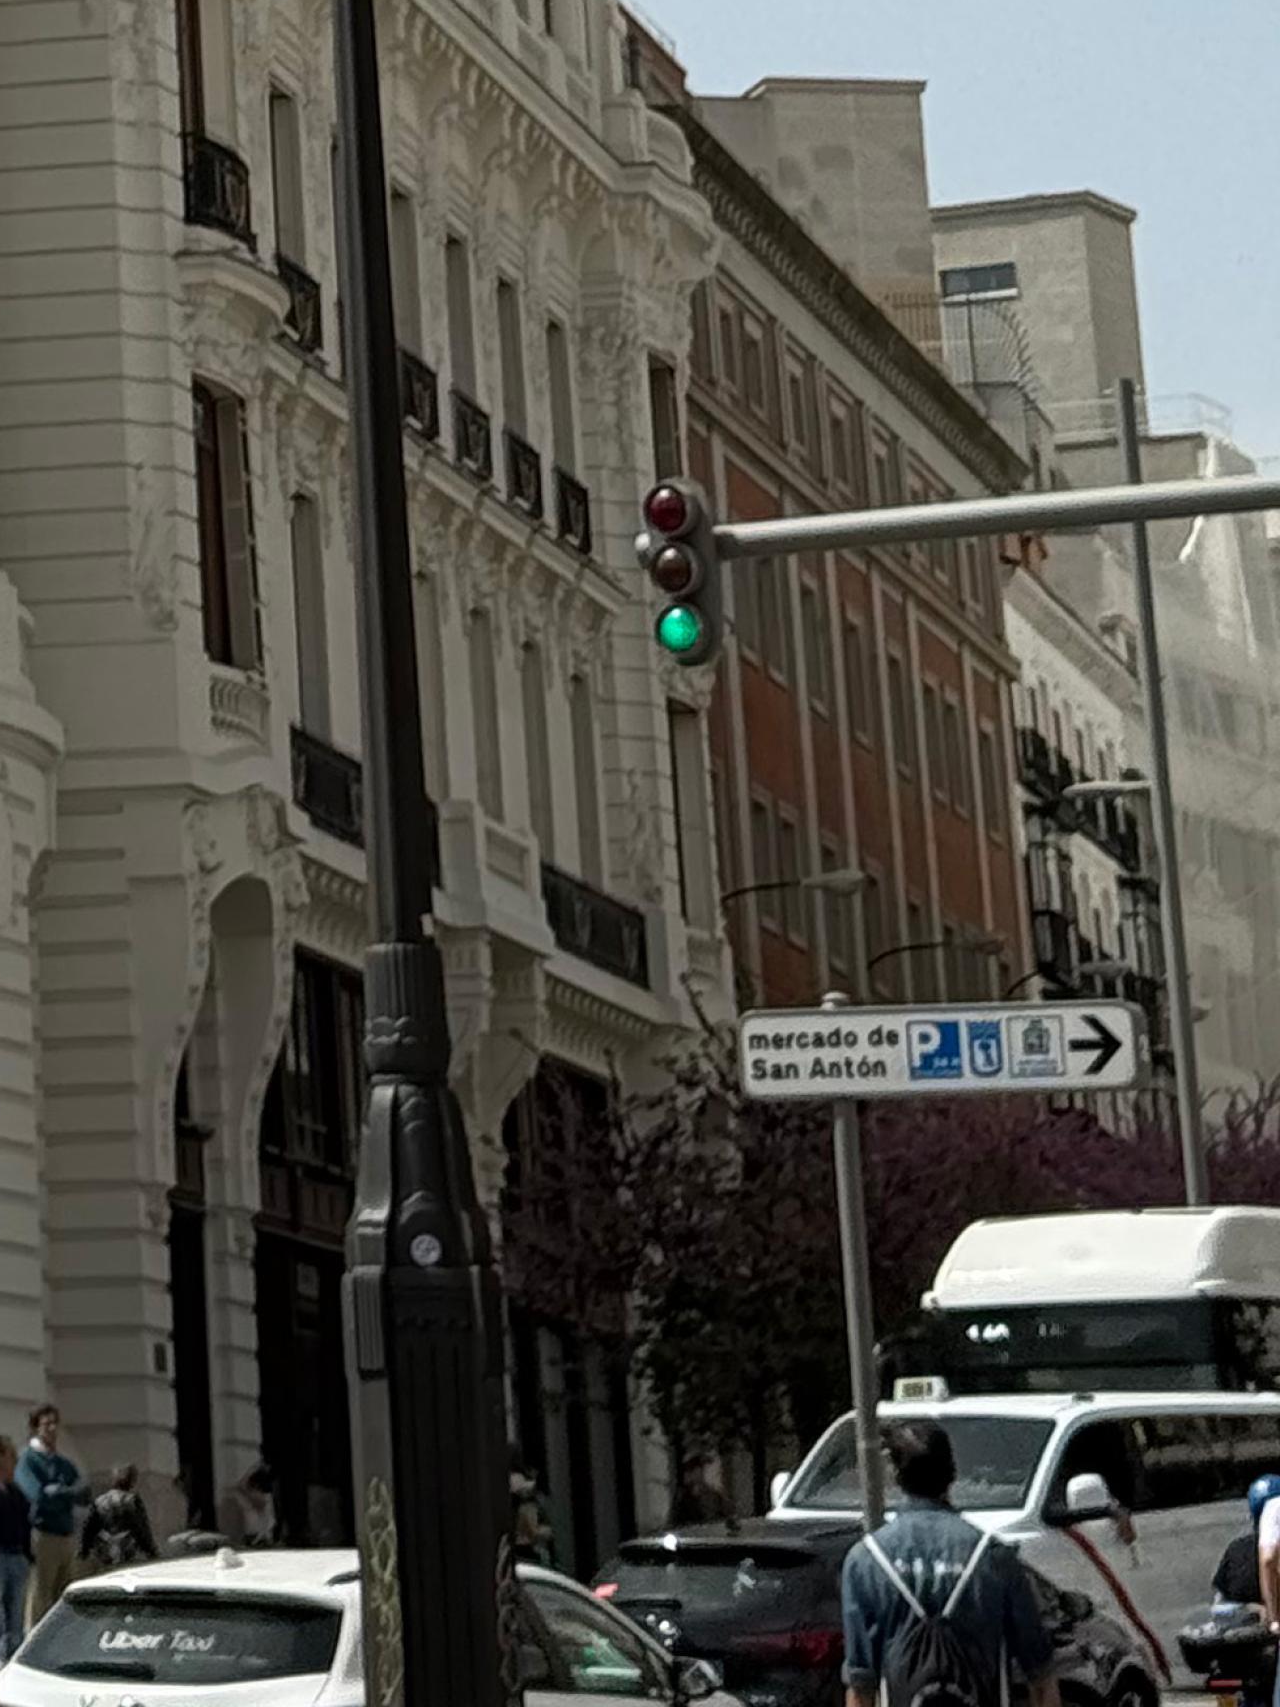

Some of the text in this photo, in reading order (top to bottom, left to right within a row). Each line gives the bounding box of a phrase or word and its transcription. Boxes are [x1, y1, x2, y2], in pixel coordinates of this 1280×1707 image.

[748, 1024, 899, 1049] mercado de
[910, 1022, 940, 1068] P
[751, 1055, 887, 1080] San Antón
